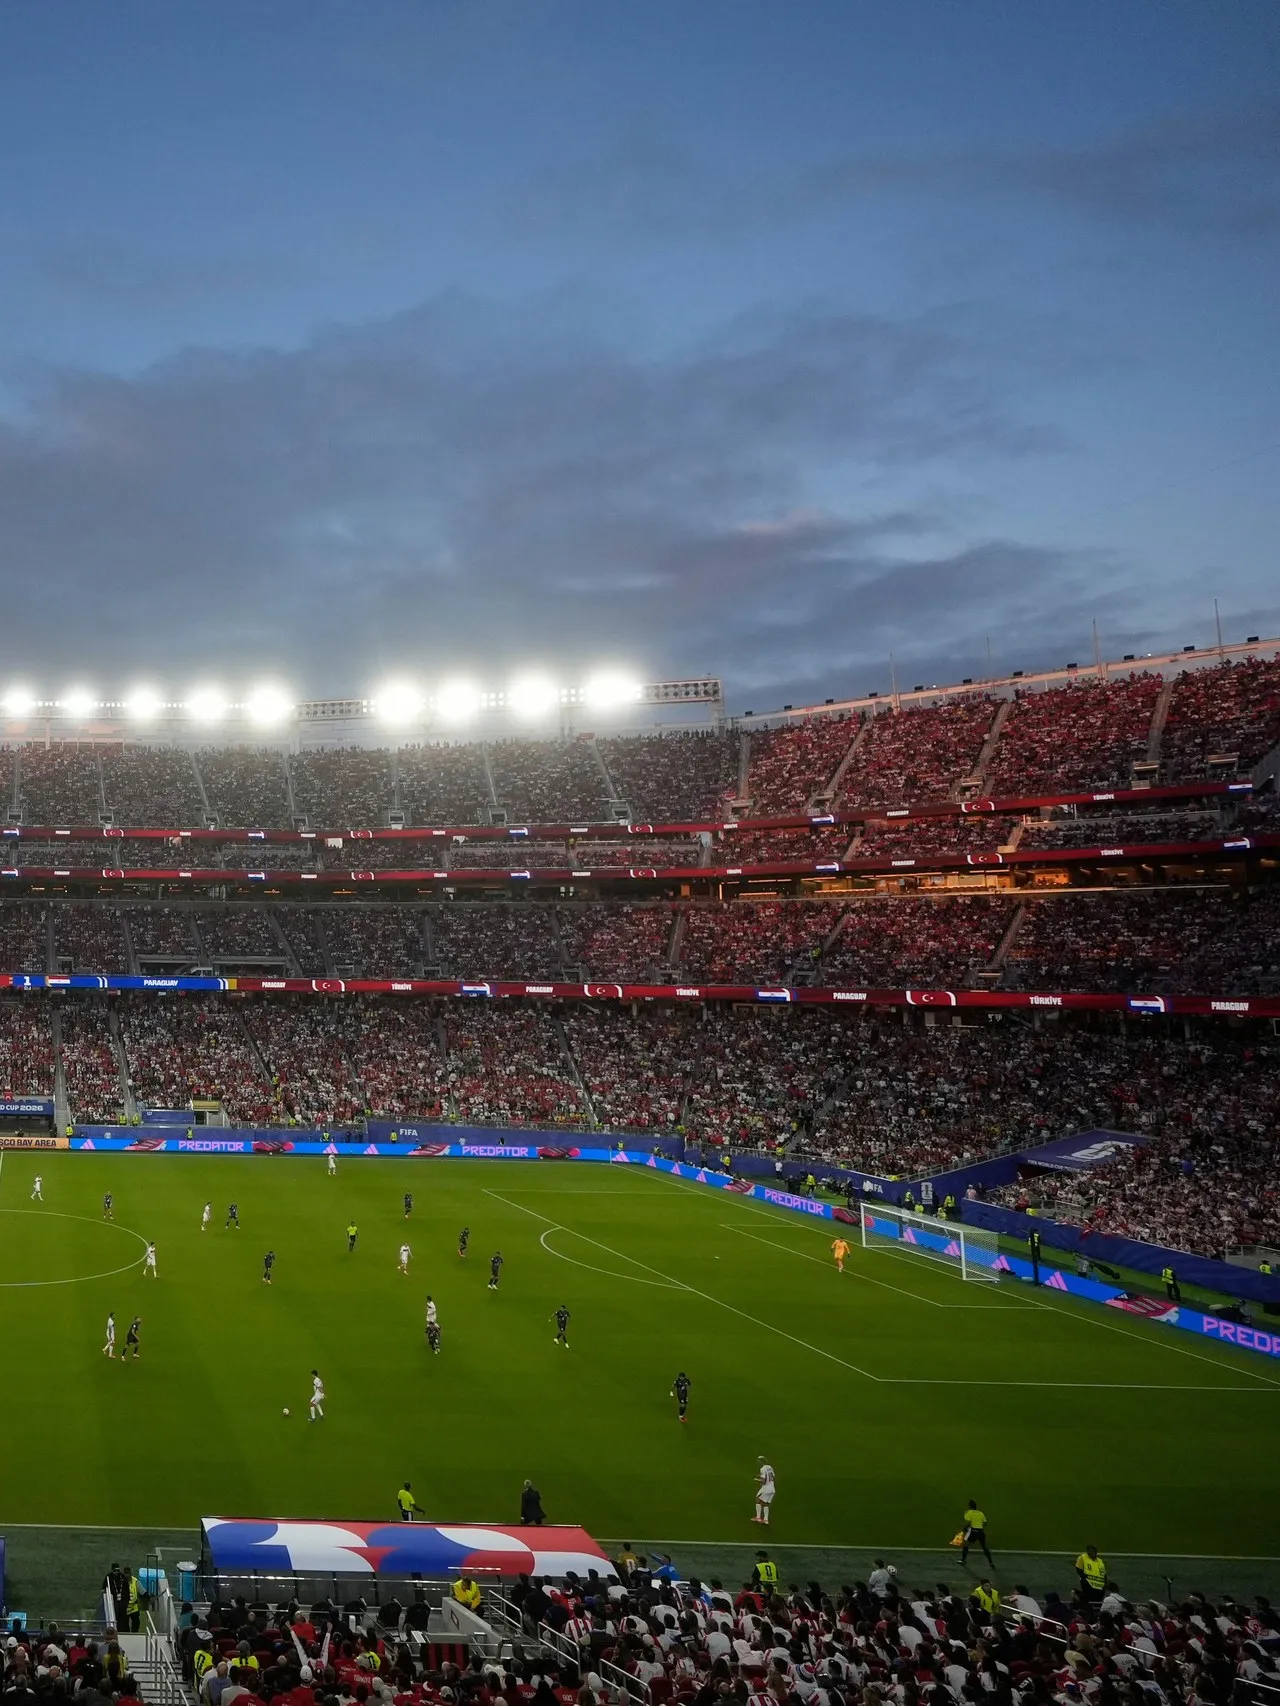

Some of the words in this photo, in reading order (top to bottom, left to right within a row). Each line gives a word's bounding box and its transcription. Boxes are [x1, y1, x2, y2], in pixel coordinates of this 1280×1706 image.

[23, 976, 31, 986] 1
[143, 979, 179, 987] PARAGUAY
[261, 981, 286, 989] PARAGUAY
[525, 985, 554, 994] PARAGUAY
[832, 992, 867, 1001] PARAGUAY
[1210, 1001, 1250, 1012] PARAGUAY
[5, 1104, 20, 1112] CUP
[399, 1128, 418, 1137] FIFA
[16, 1139, 33, 1147] BAY
[34, 1139, 57, 1147] AREA
[180, 1140, 243, 1151] PREDATOR
[464, 1145, 527, 1156] PREDATOR
[764, 1189, 824, 1214] PREDATOR
